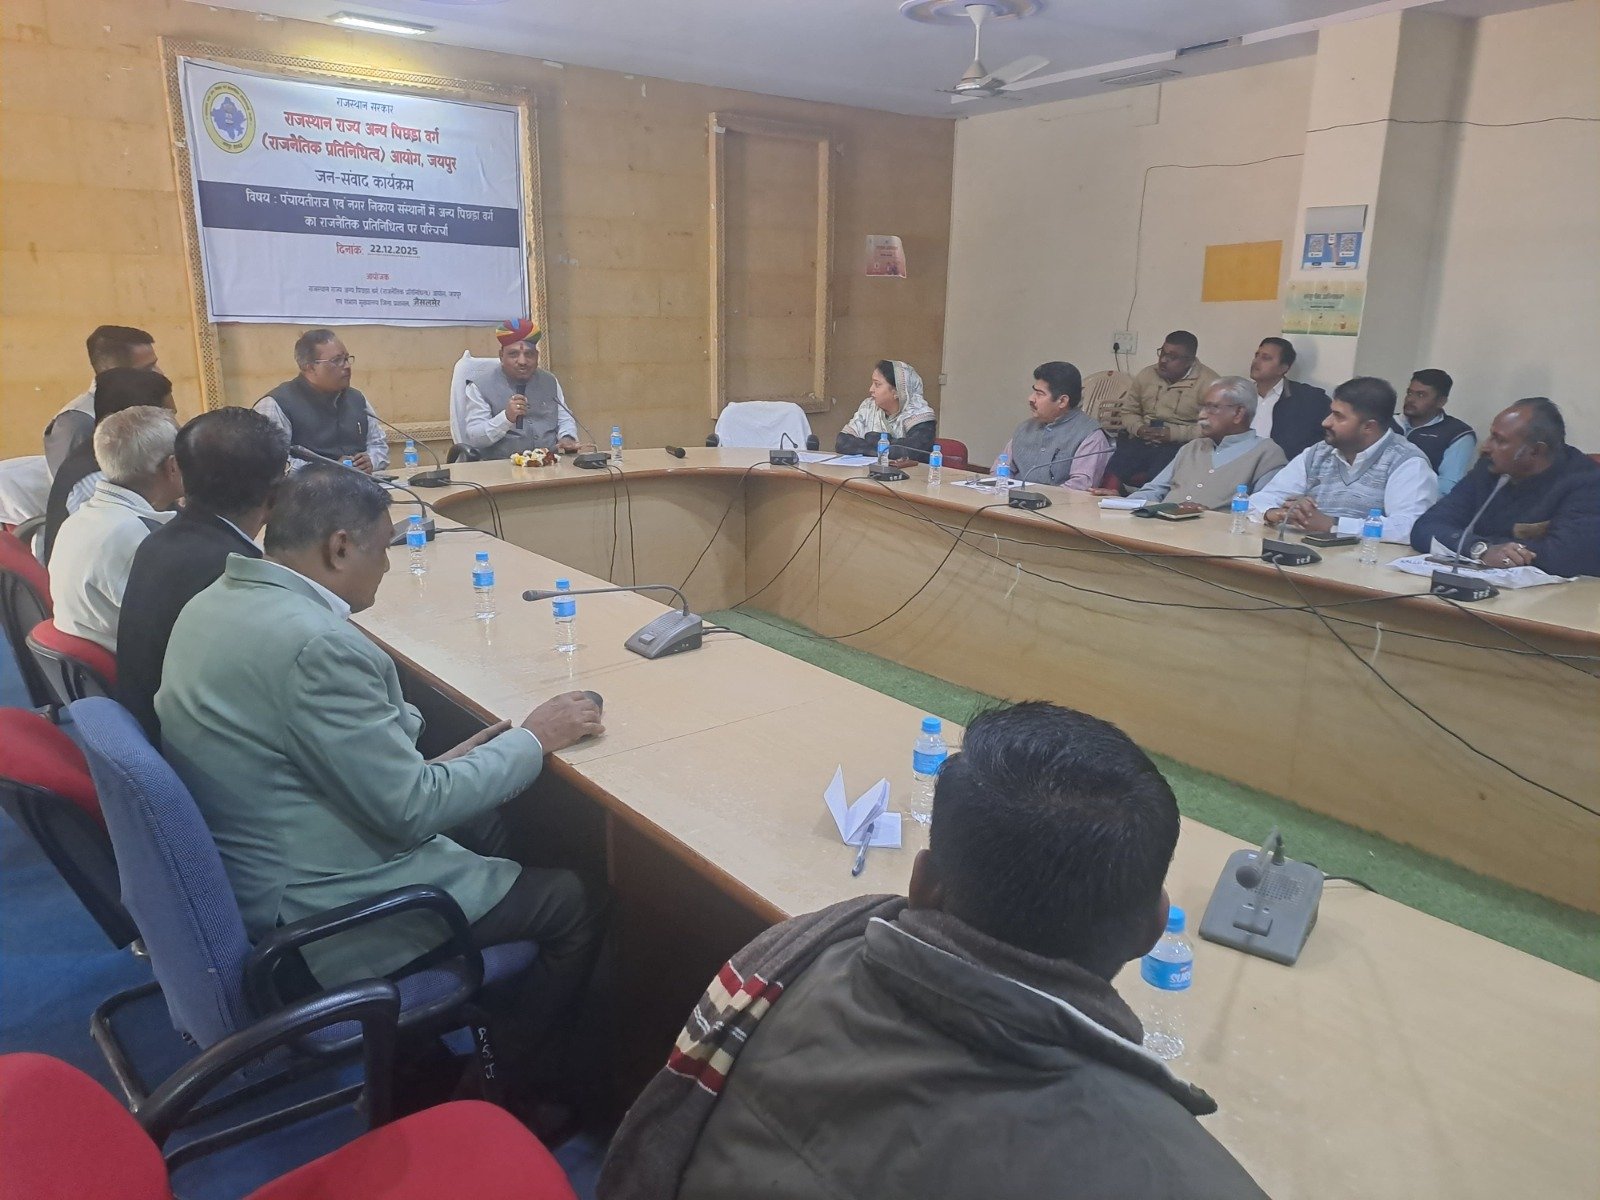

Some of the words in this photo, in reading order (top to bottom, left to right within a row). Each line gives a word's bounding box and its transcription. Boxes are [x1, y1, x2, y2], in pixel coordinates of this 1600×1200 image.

[336, 97, 368, 111] राजस्थान
[371, 102, 394, 114] सरकार
[283, 111, 333, 131] राजस्थान
[335, 118, 361, 134] राज्य
[365, 122, 387, 138] अन्य
[391, 122, 421, 143] पिछड़ा
[424, 127, 439, 144] वर्ग
[262, 132, 322, 155] (राजनैतिक
[325, 139, 385, 163] प्रतिनिधित्व)
[390, 149, 424, 167] आयोग,
[427, 154, 457, 174] जयपुर
[315, 169, 369, 189] जन-संवाद
[372, 173, 414, 191] कार्यक्रम
[245, 188, 270, 203] विषय
[280, 191, 330, 208] पंचायतीराज
[333, 196, 345, 210] एवं
[347, 199, 365, 211] नगर
[368, 199, 394, 213] निकाय
[397, 202, 426, 216] संस्थानों
[439, 208, 455, 218] अन्य
[482, 209, 494, 221] वर्ग
[304, 216, 317, 227] का
[362, 218, 405, 233] प्रतिनिधित्व
[407, 223, 418, 234] पर
[420, 222, 449, 236] परिचर्चा
[370, 244, 419, 256] 22.12.2025
